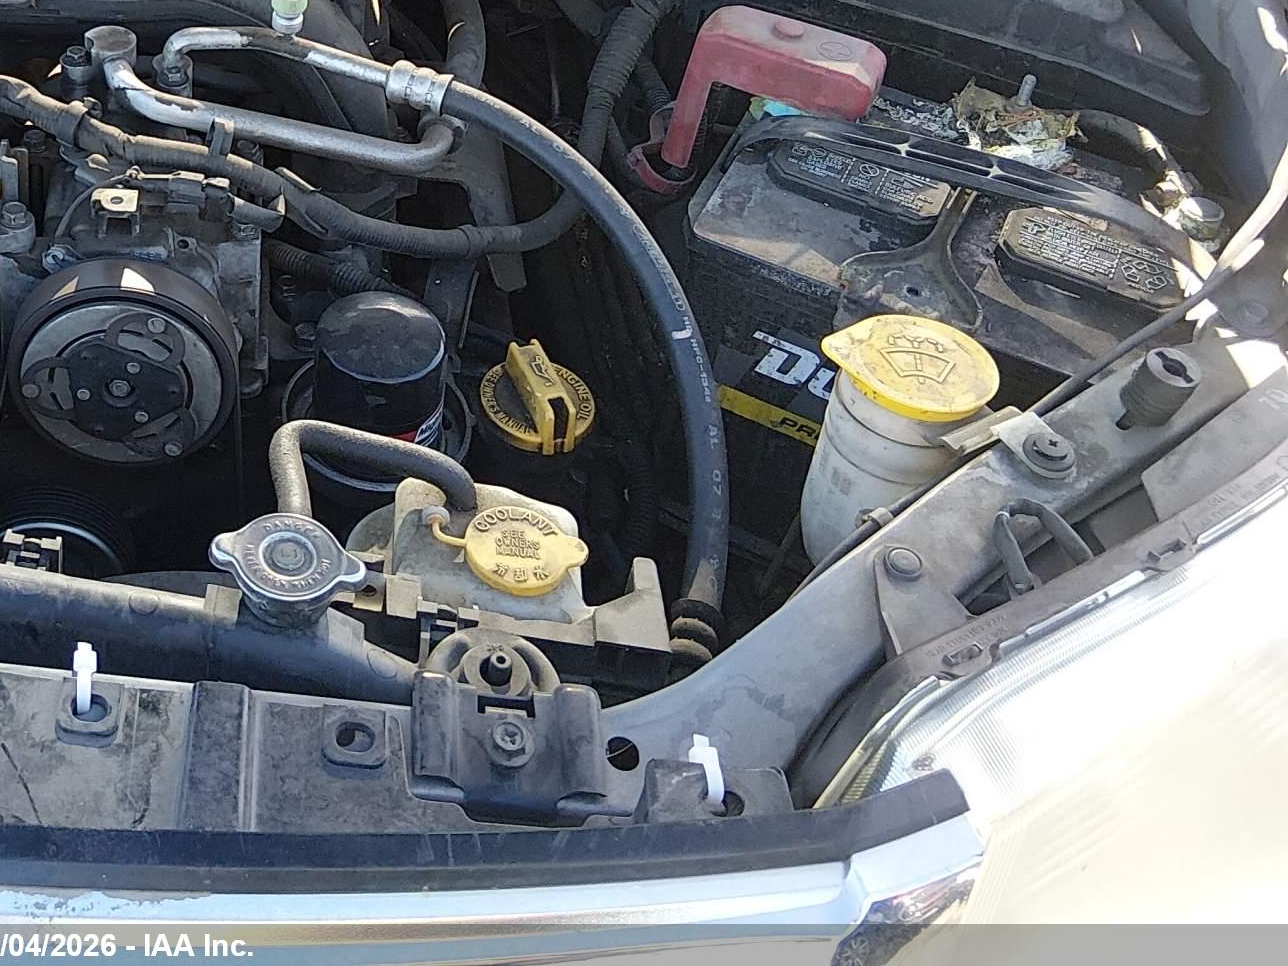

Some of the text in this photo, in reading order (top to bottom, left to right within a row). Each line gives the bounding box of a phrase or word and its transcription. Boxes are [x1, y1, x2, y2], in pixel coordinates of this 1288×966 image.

[576, 402, 592, 420] OIL
[494, 411, 530, 435] MANUAL
[473, 507, 559, 537] COOLANT
[501, 529, 526, 539] SEE
[495, 545, 541, 560] MANUAL
